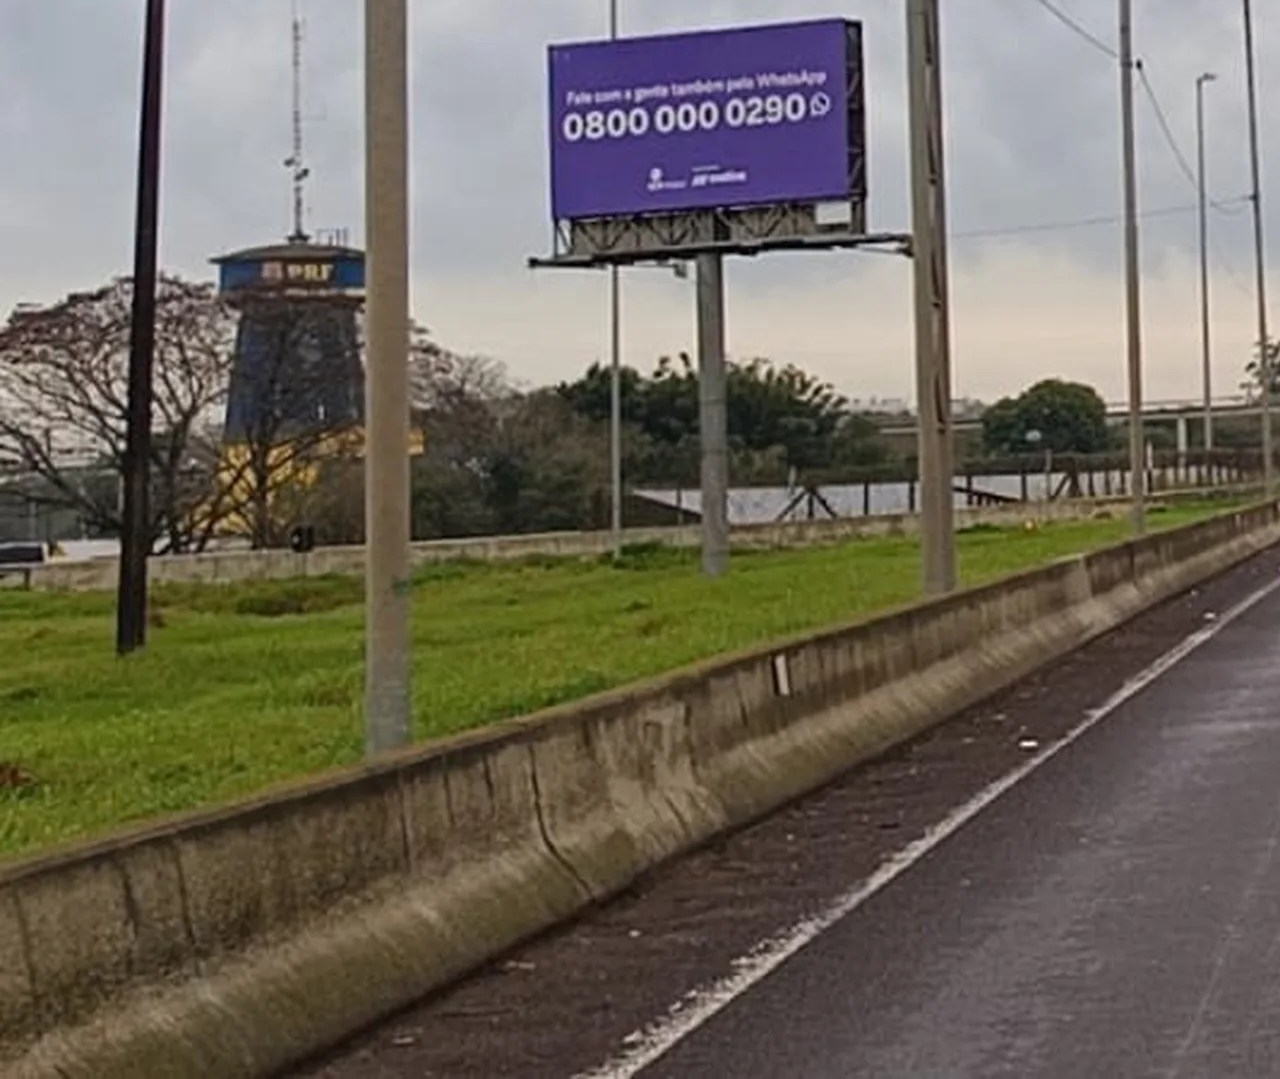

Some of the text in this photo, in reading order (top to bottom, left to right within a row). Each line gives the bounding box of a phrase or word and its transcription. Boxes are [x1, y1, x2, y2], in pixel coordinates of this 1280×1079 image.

[564, 92, 806, 141] 0800 000 0290
